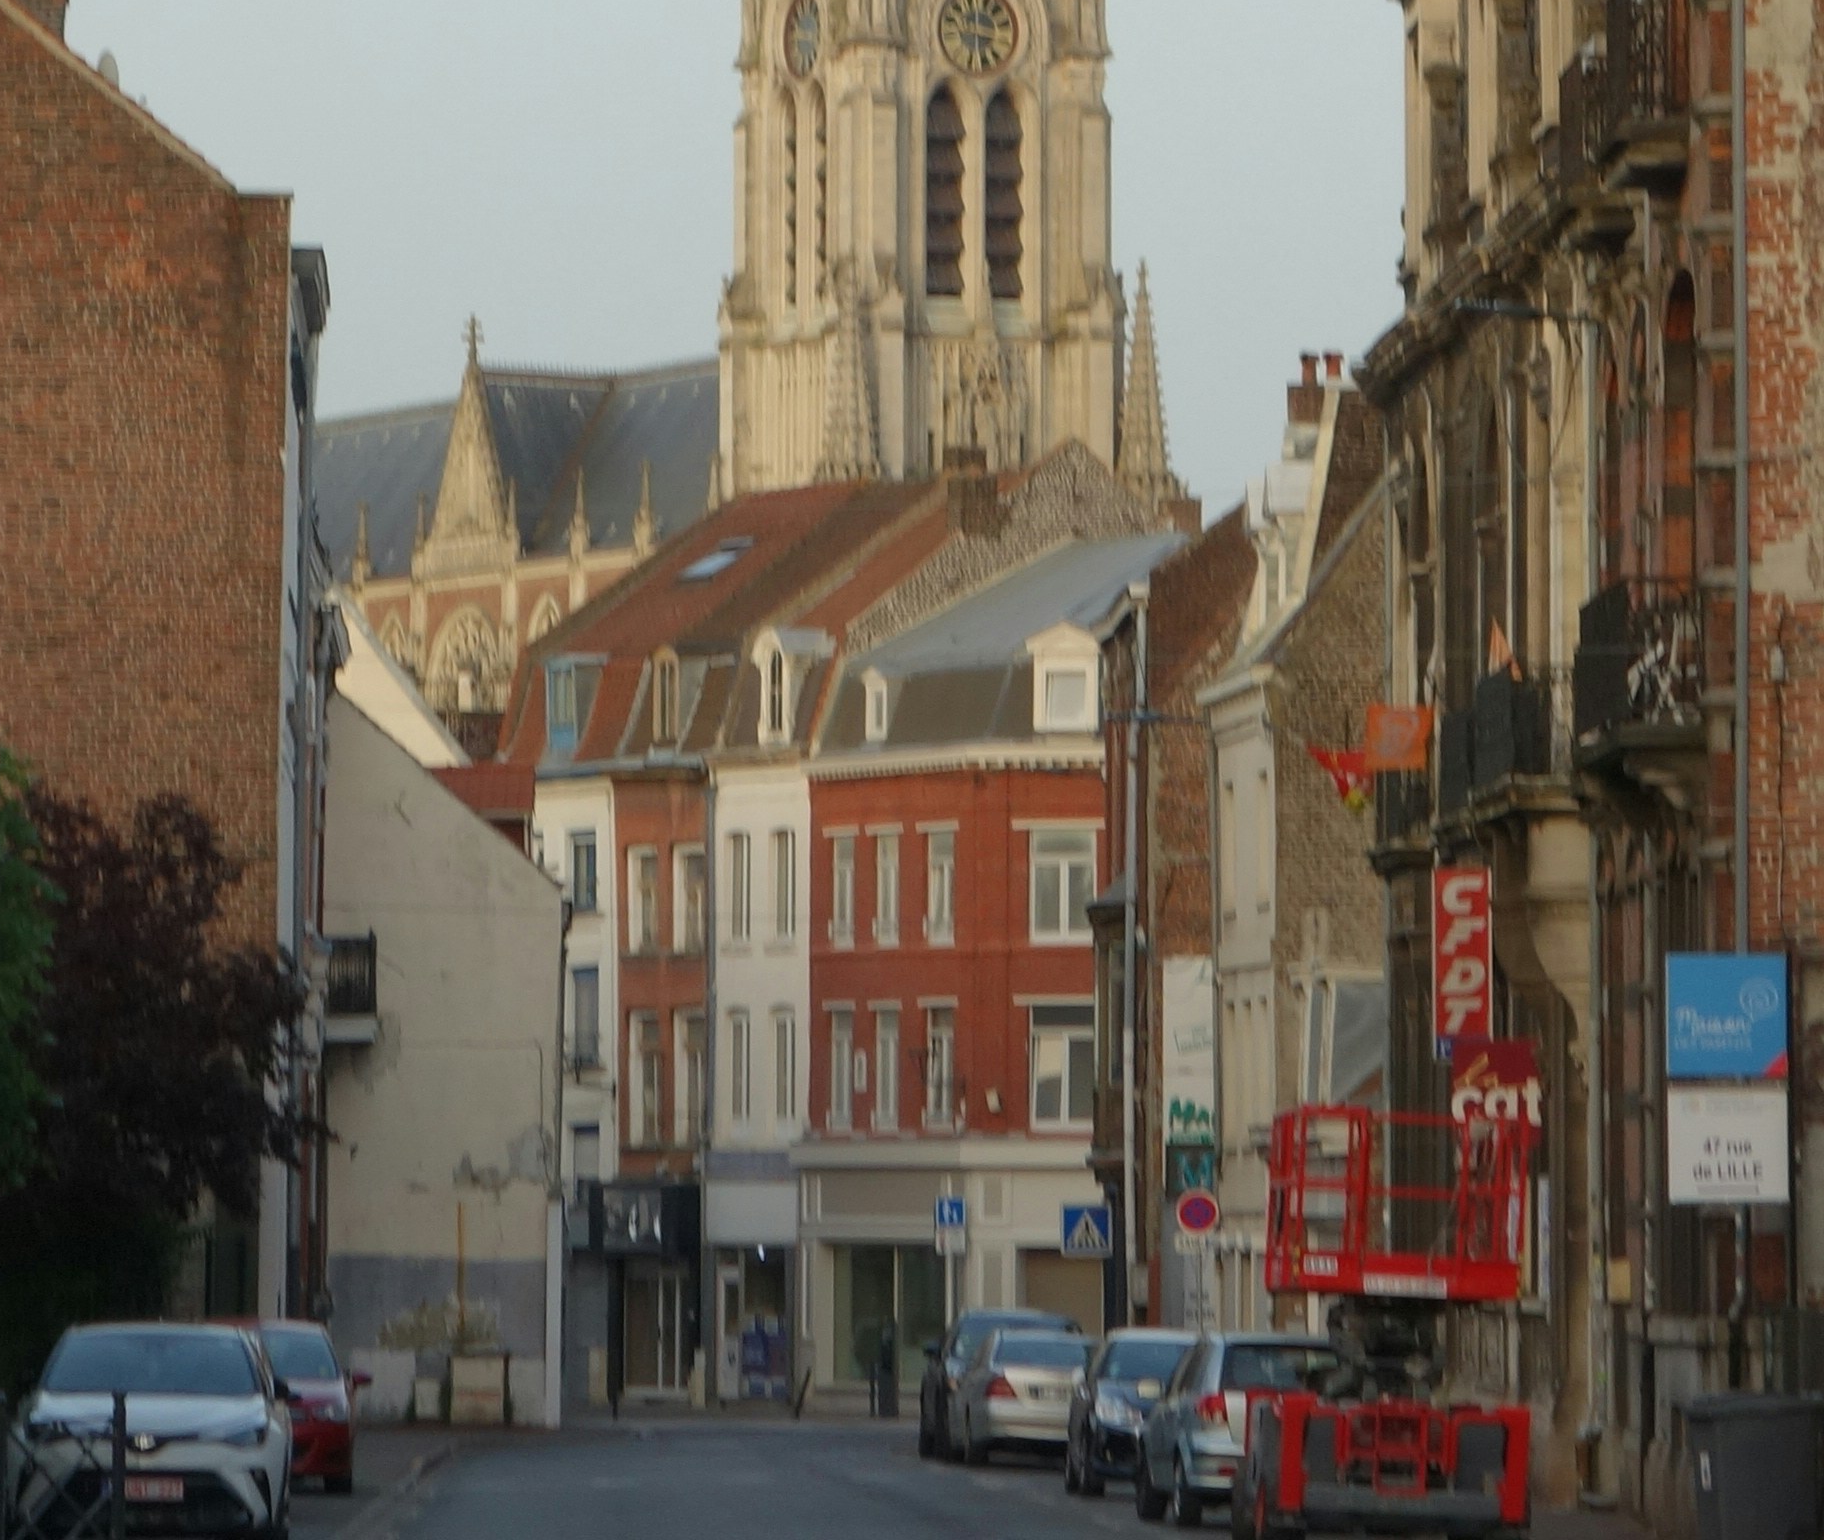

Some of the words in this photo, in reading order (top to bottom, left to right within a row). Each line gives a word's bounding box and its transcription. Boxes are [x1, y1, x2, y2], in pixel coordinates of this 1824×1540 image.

[1440, 873, 1487, 1035] CFDT
[1727, 1139, 1753, 1157] rue
[1693, 1160, 1712, 1181] de
[1717, 1160, 1763, 1181] LILLE
